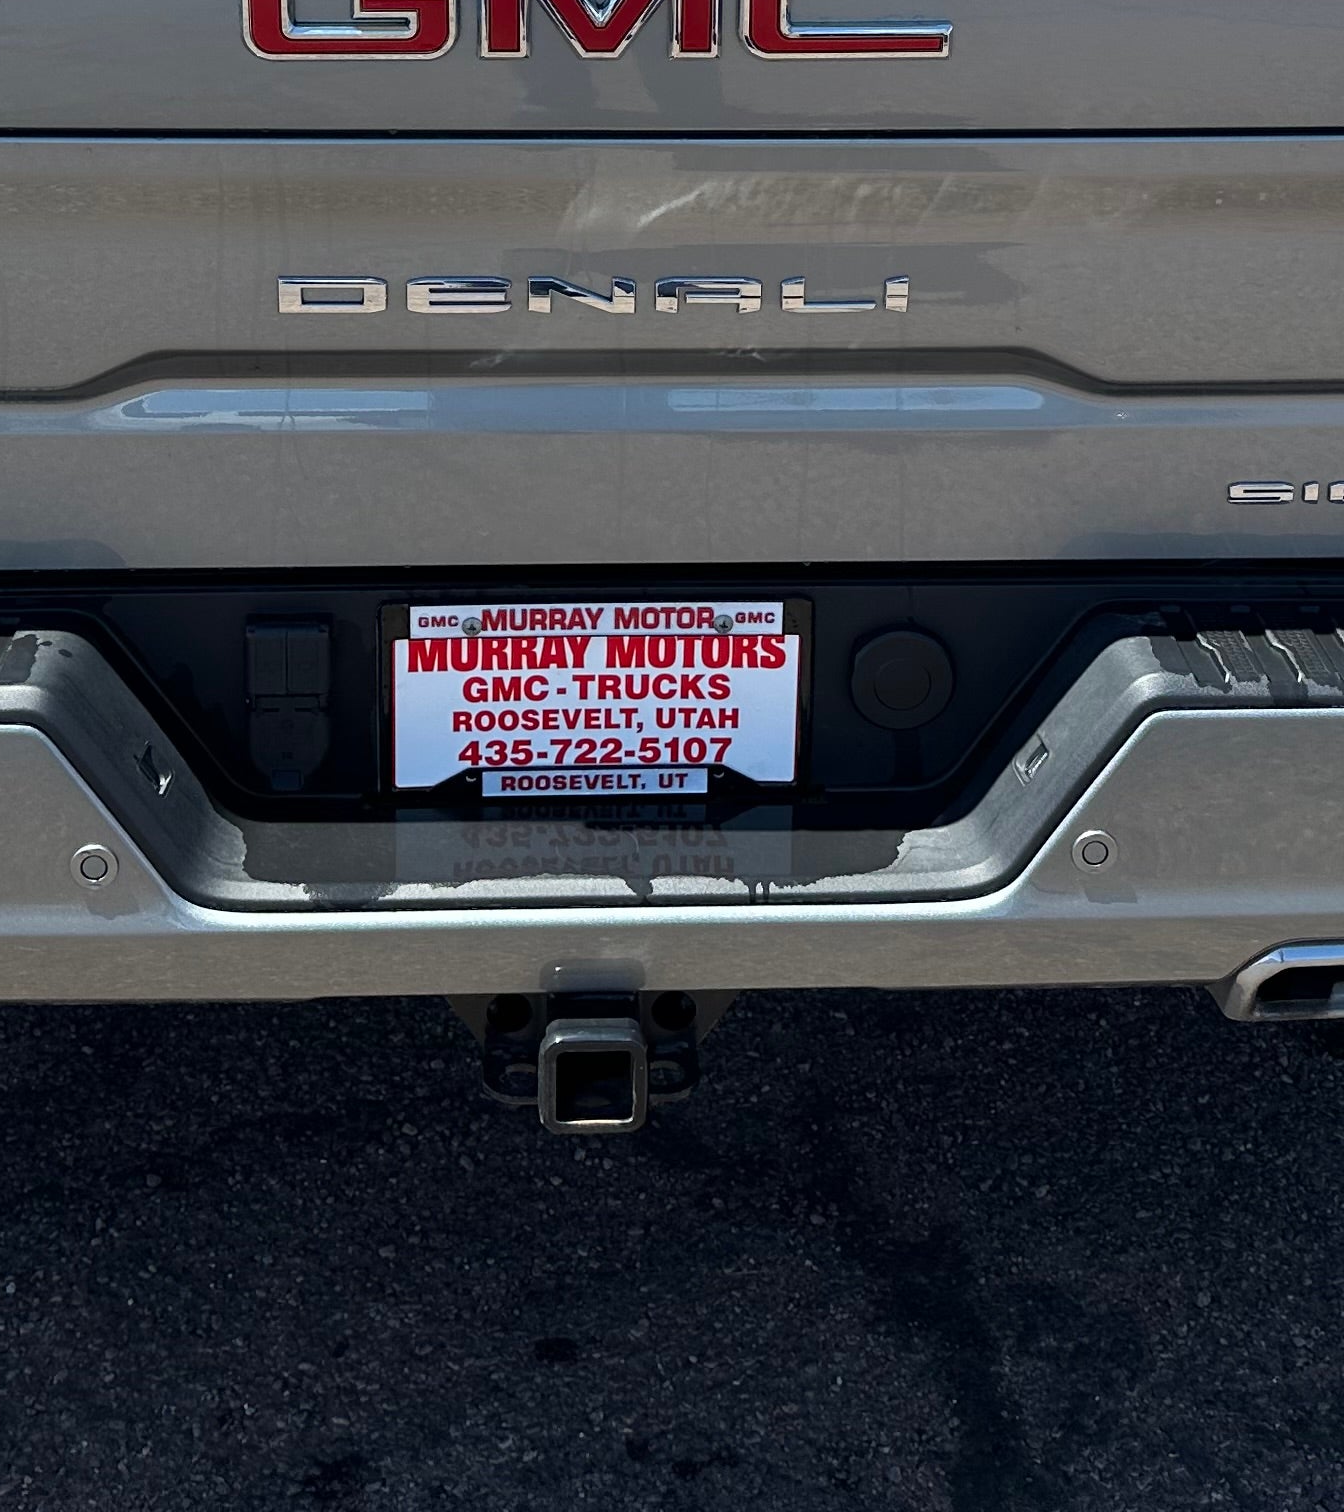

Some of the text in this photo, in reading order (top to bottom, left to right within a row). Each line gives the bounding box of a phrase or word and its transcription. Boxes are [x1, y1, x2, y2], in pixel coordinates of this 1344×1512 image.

[277, 274, 910, 314] DENALI
[418, 606, 776, 631] GMC MURRAY MOTOR GMC
[407, 635, 787, 673] MURRAY MOTORS
[452, 707, 740, 734] ROOSEVELT, UTAH
[458, 736, 733, 767] 435-722-5107
[500, 772, 689, 792] ROOSEVELT, UT
